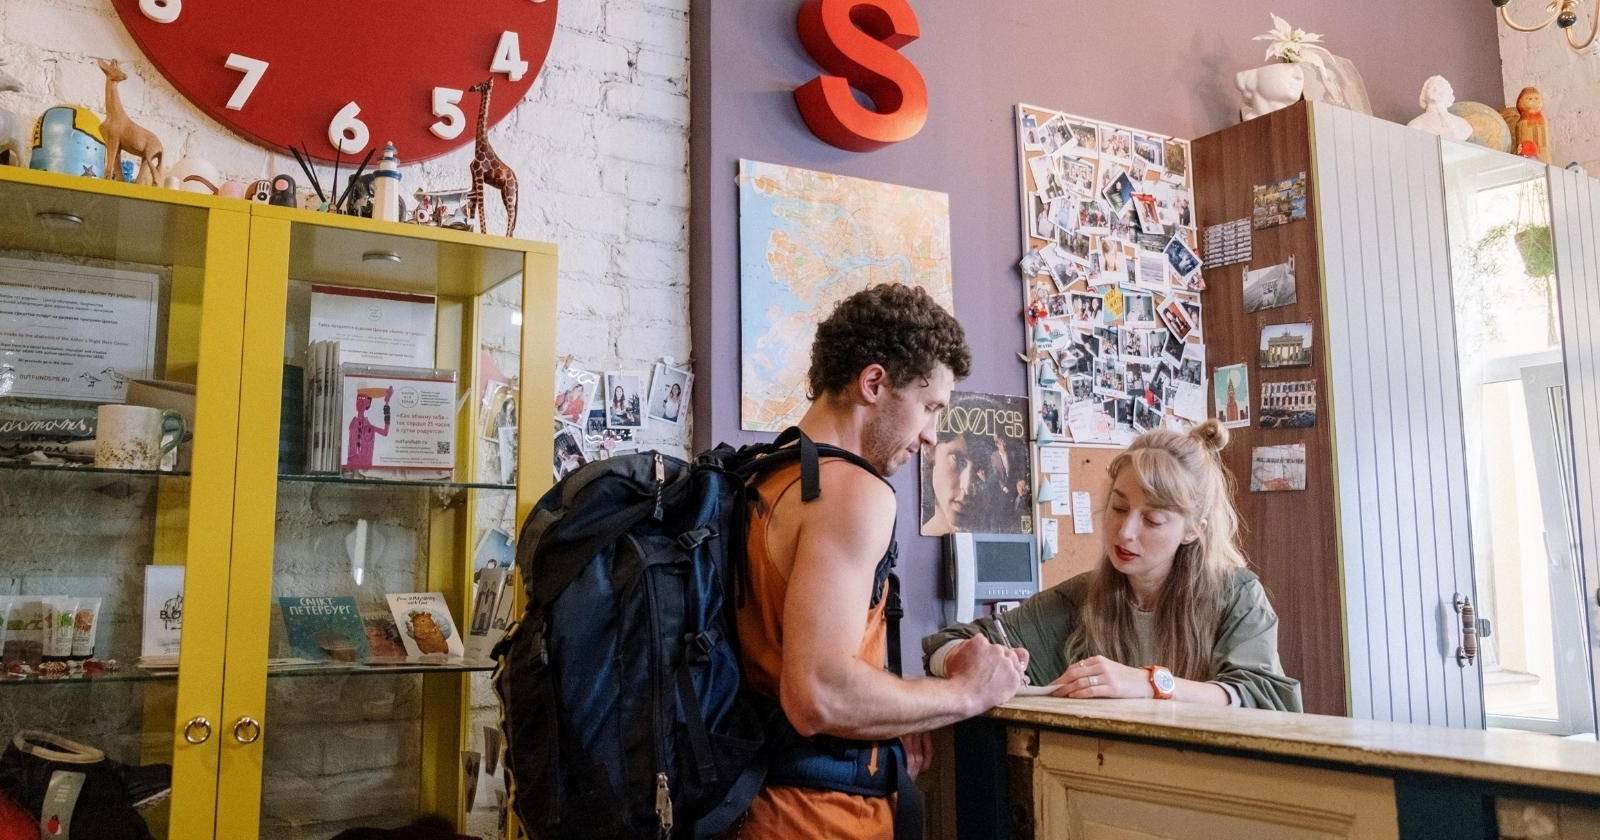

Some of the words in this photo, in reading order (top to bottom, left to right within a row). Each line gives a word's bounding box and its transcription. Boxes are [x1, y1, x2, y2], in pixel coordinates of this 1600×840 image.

[224, 52, 269, 111] 7
[490, 30, 529, 82] 4
[793, 0, 928, 153] S
[328, 101, 370, 155] 6
[429, 86, 466, 140] 5
[289, 605, 352, 616] ПЕТЕРБУРГ
